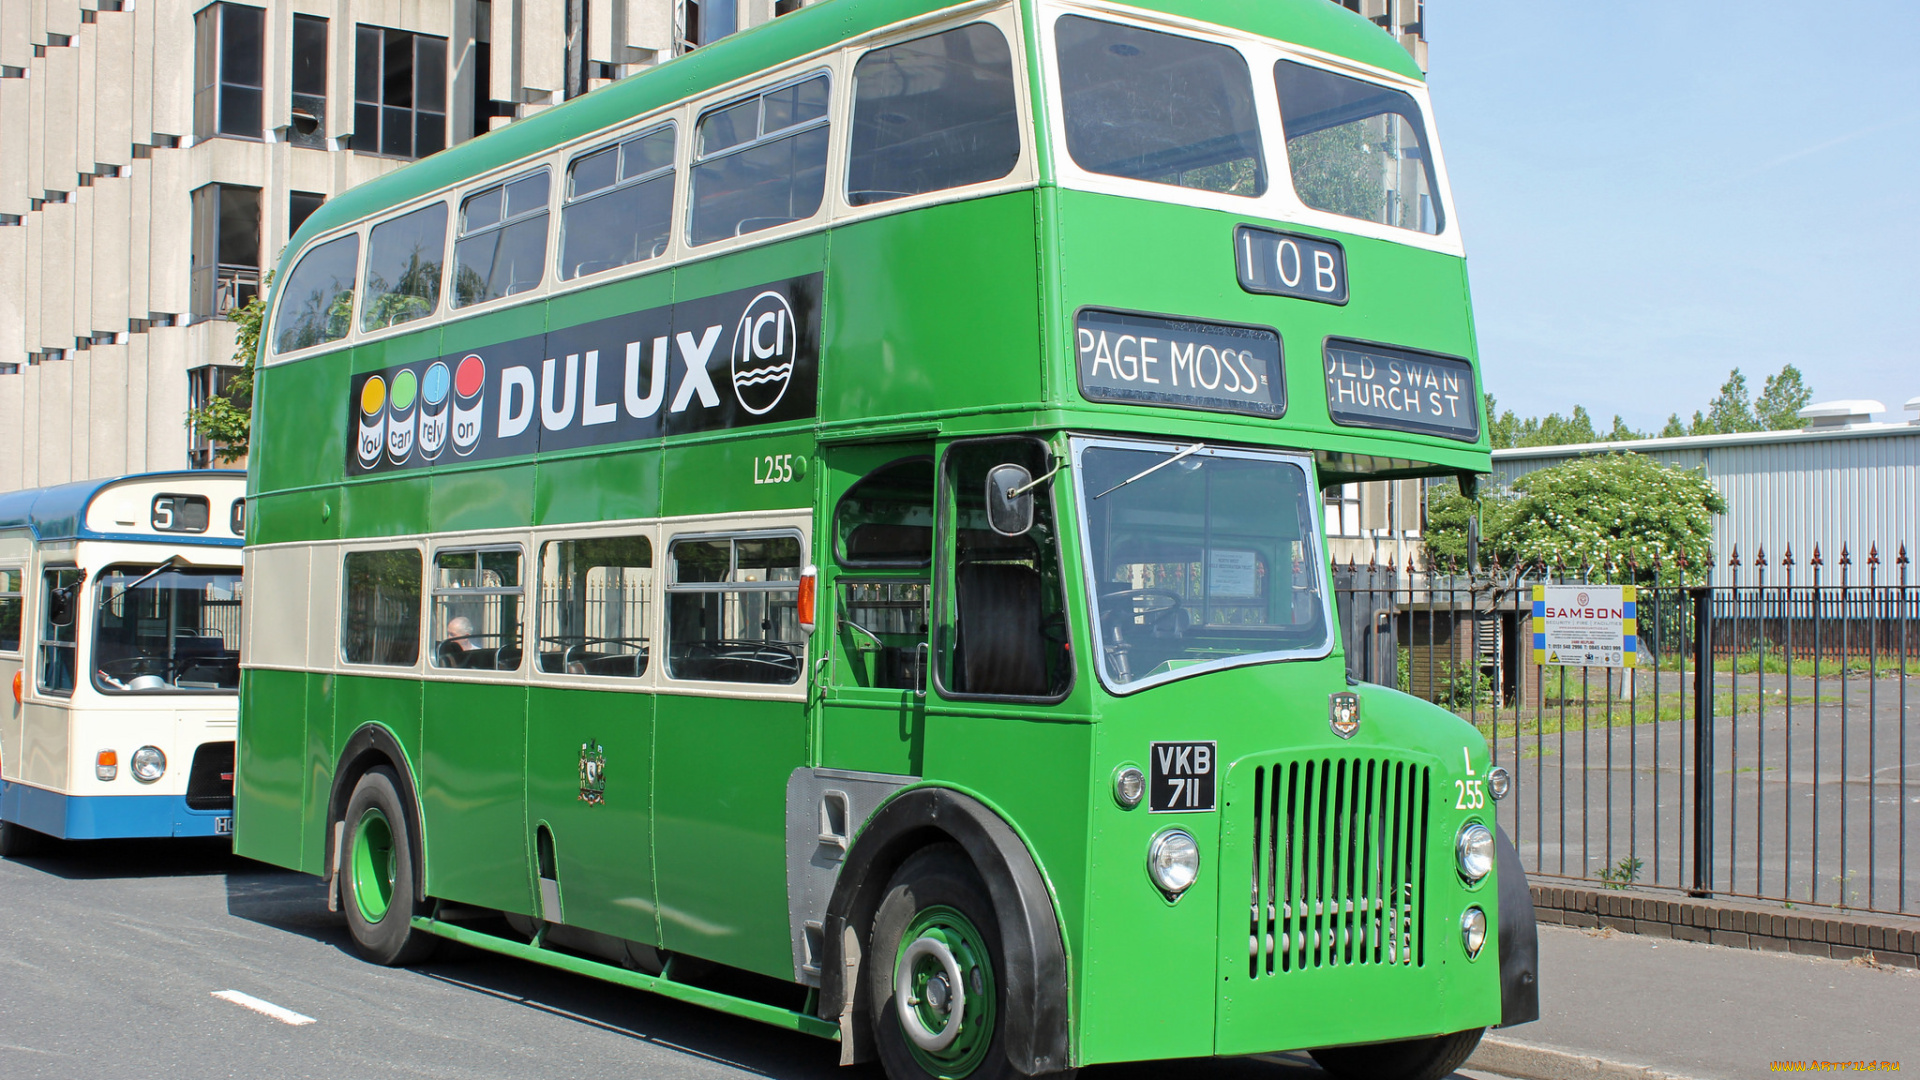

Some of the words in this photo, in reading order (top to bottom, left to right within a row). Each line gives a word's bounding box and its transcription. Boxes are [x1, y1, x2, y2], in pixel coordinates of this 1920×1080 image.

[743, 309, 786, 363] ICI
[1078, 327, 1160, 384] PAGE
[1170, 340, 1258, 394] MOSS
[498, 324, 723, 438] DULUX
[1389, 361, 1459, 393] SWAN
[1429, 392, 1459, 418] ST
[360, 431, 382, 454] You
[391, 429, 411, 449] can
[422, 419, 444, 447] rely
[457, 422, 474, 439] on
[754, 454, 793, 484] L255
[153, 499, 174, 529] 5
[1546, 607, 1622, 619] SAMSON
[1157, 746, 1211, 775] VKB
[1463, 746, 1476, 776] L
[1168, 778, 1199, 808] 711
[1455, 779, 1485, 810] 255
